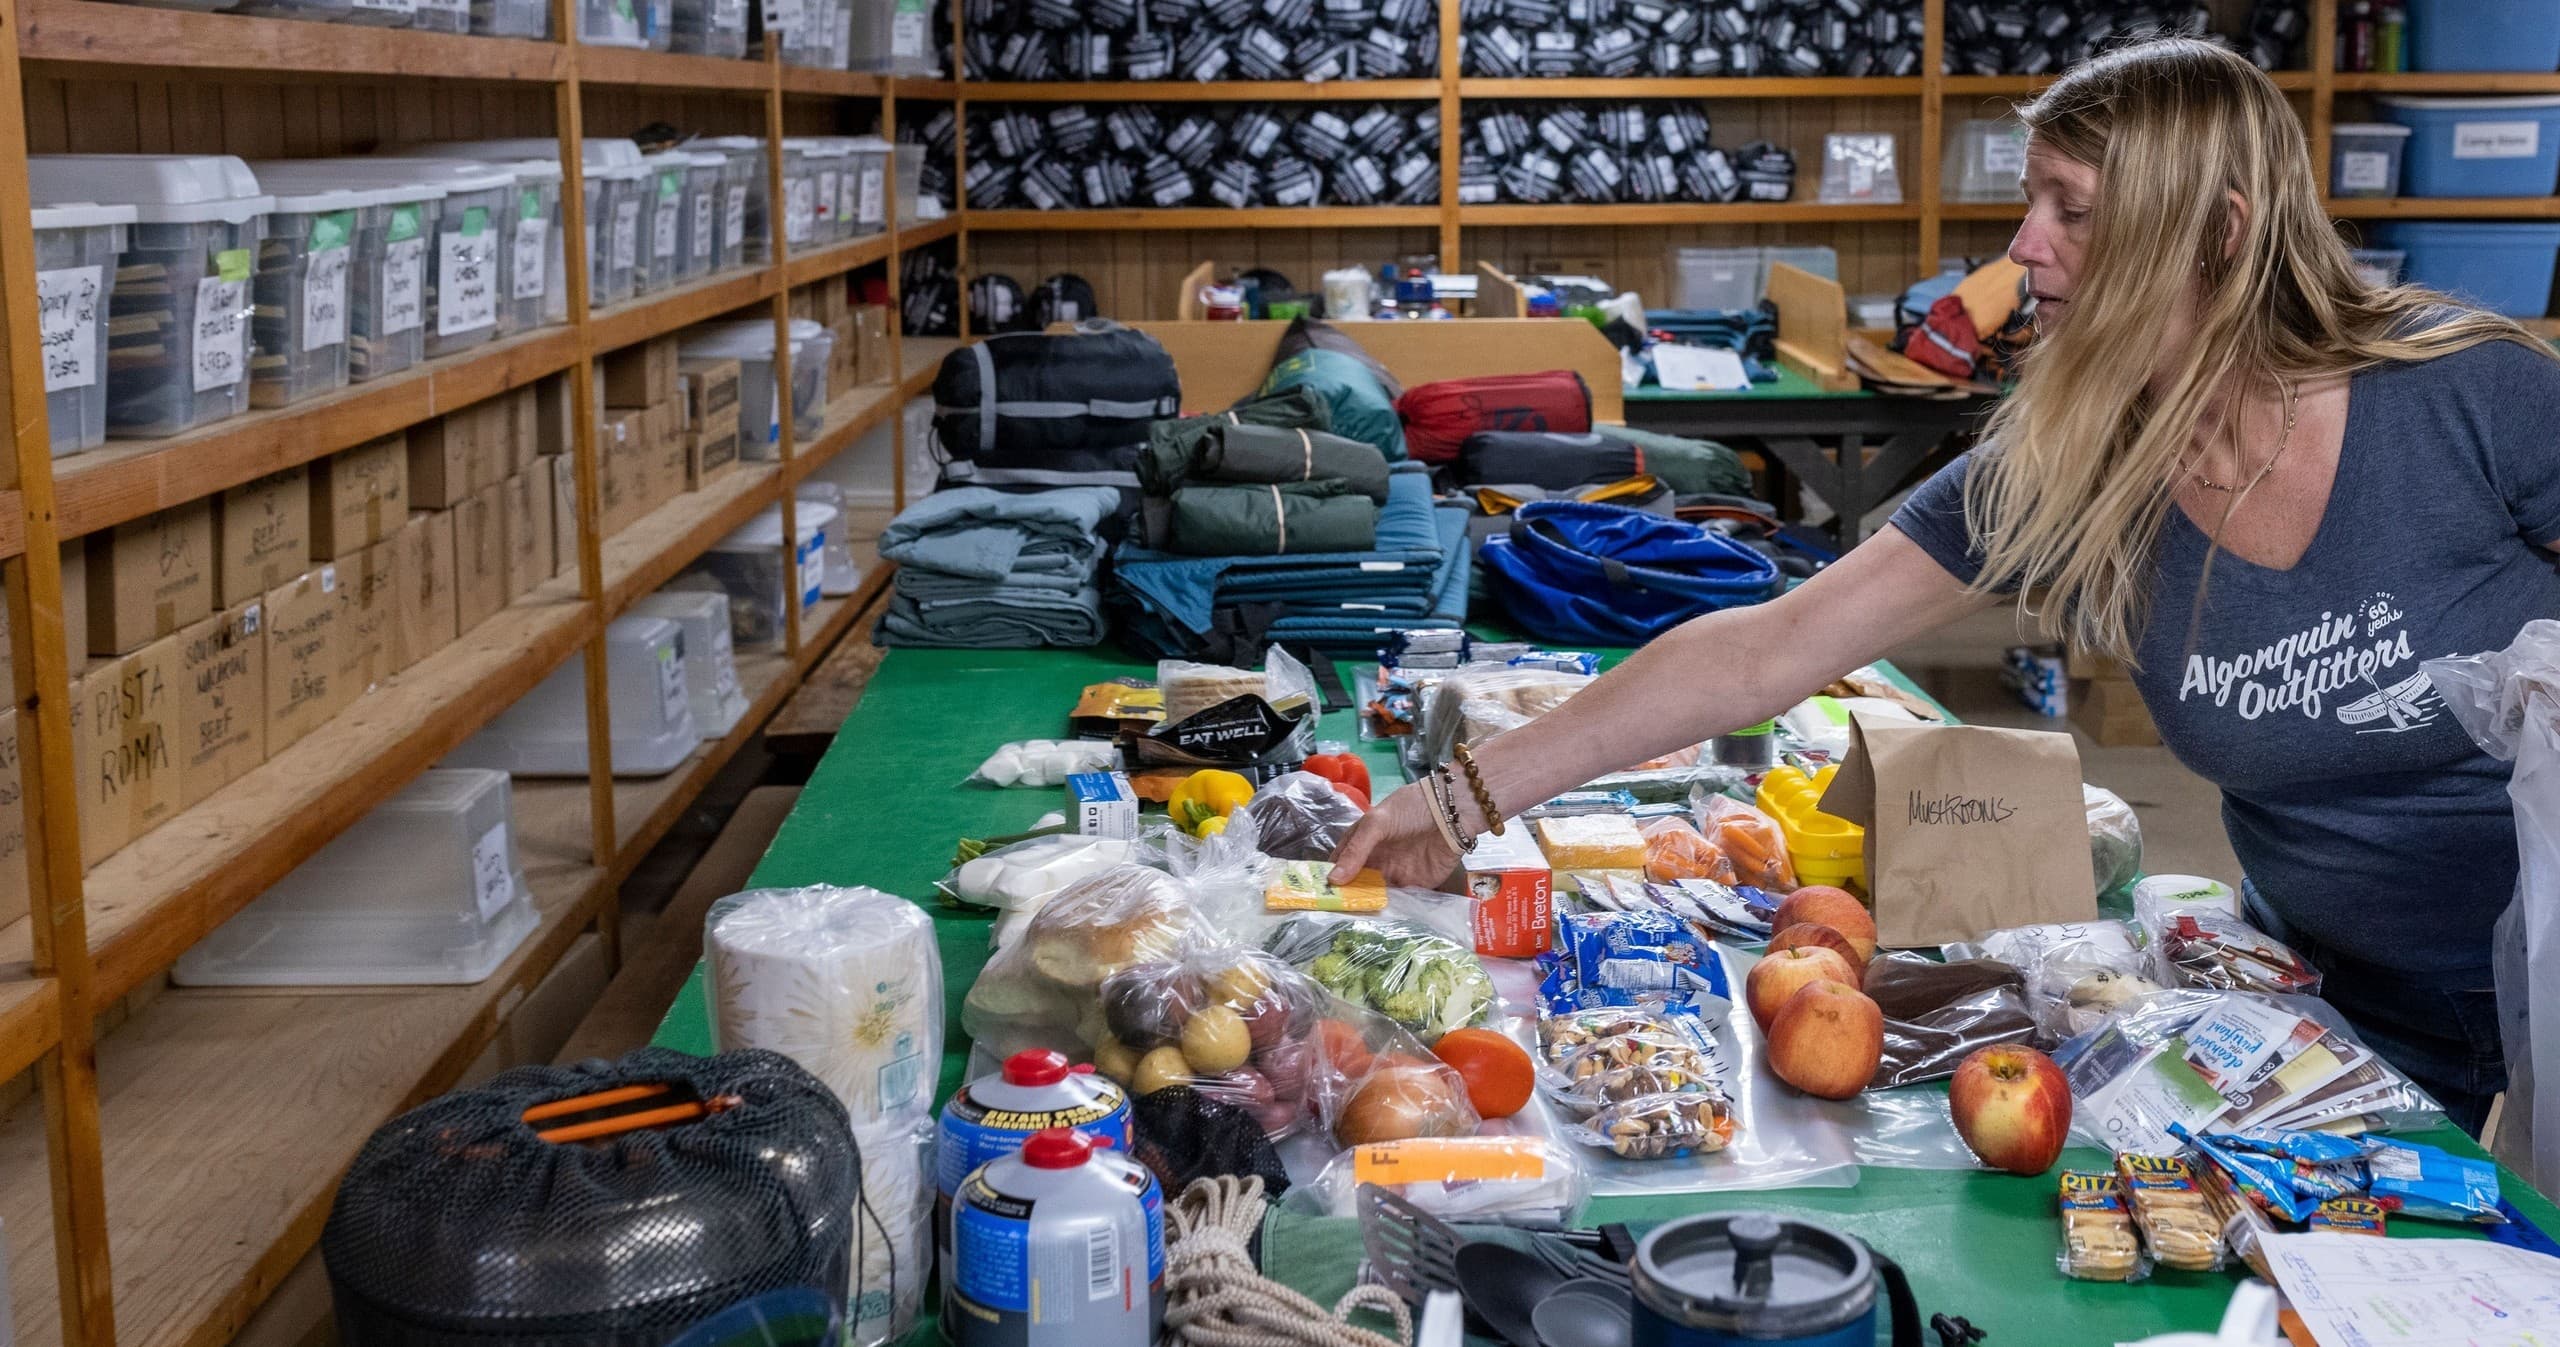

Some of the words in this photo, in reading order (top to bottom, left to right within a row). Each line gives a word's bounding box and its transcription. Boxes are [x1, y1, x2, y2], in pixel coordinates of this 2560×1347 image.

[2367, 608, 2403, 638] years
[2368, 600, 2389, 620] 60
[2179, 611, 2359, 708] Algonquin
[2238, 630, 2415, 720] Outfitters
[95, 663, 165, 737] PASTA
[1179, 731, 1214, 747] EAT
[1215, 724, 1266, 742] WELL
[101, 723, 169, 804] ROMA
[1530, 877, 1547, 932] Breton
[2190, 1033, 2243, 1069] cleansed
[2205, 1020, 2263, 1055] purifiant
[2122, 1154, 2177, 1171] RITZ
[2061, 1174, 2113, 1192] RITZ
